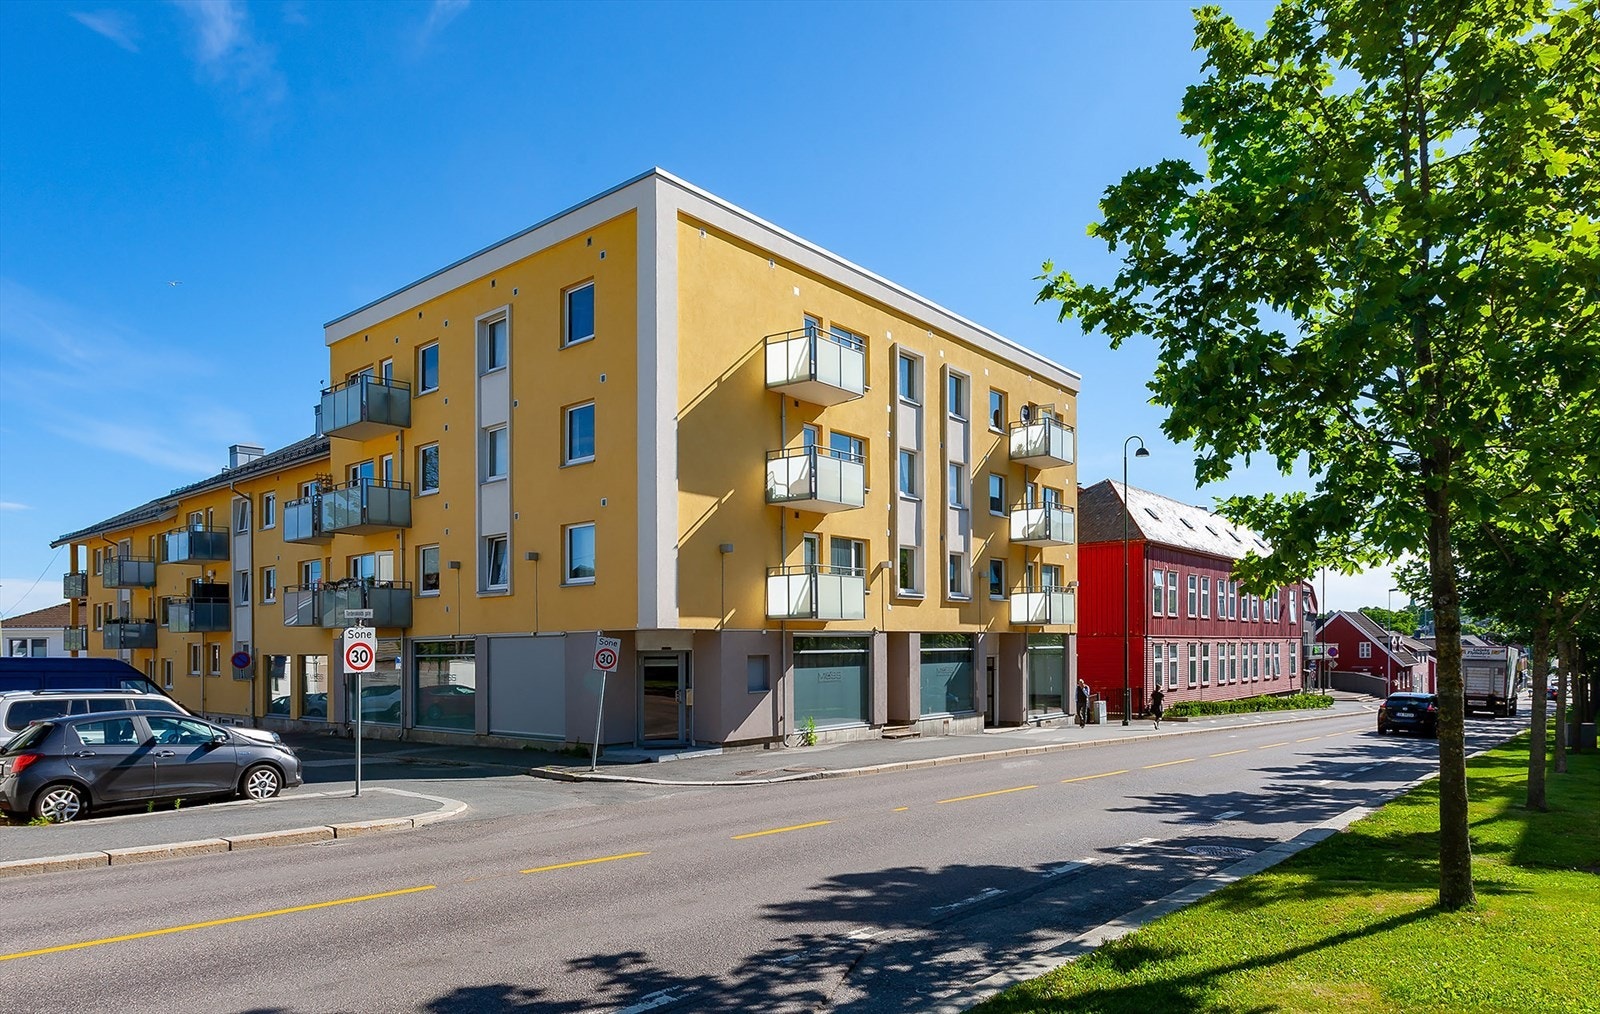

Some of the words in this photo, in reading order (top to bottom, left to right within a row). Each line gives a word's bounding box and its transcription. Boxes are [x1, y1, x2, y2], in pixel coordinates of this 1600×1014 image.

[348, 630, 372, 639] Sone
[599, 638, 617, 647] Sone
[352, 650, 368, 663] 30
[600, 653, 613, 664] 30
